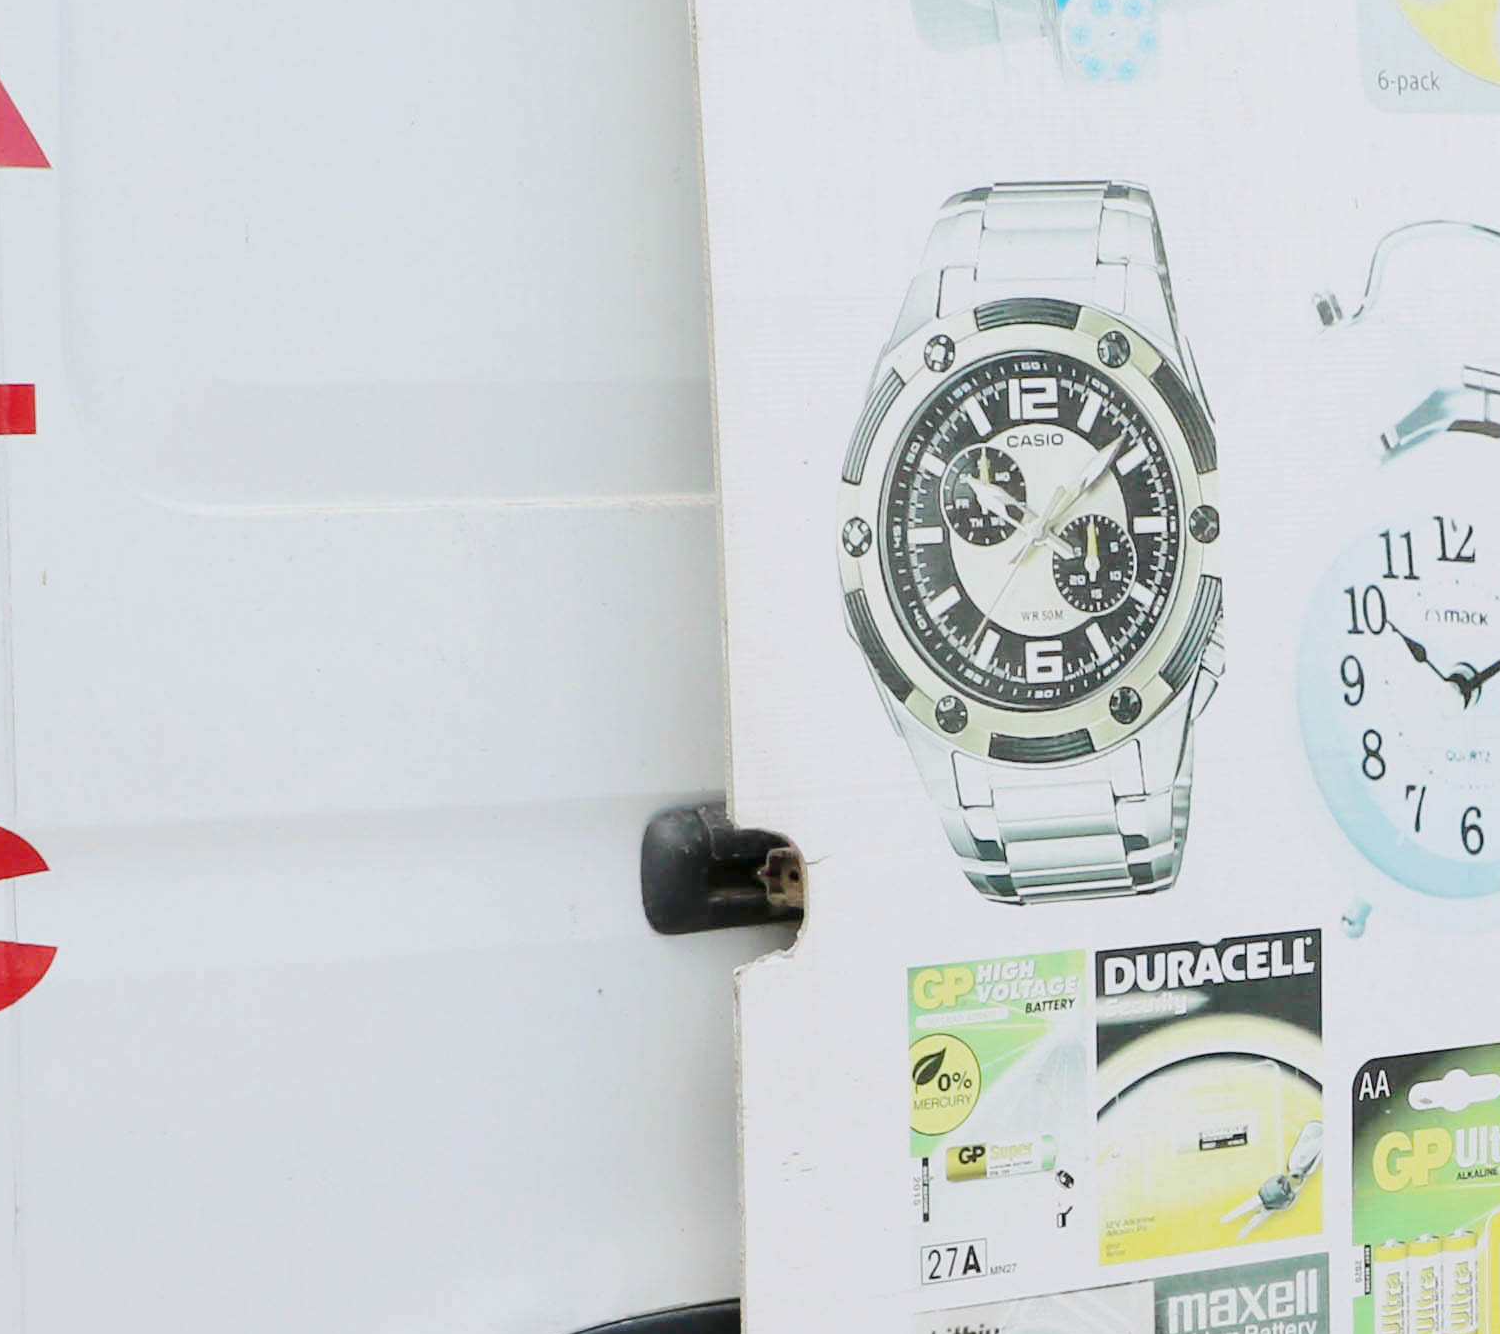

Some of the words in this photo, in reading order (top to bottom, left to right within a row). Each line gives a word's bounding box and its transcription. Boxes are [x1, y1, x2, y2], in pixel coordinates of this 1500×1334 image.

[1378, 71, 1440, 93] 6-pack
[1008, 377, 1059, 420] 12
[1006, 433, 1064, 448] CASIO
[1379, 529, 1420, 580] 11
[1344, 585, 1387, 634] 10
[1025, 640, 1063, 684] 6
[1341, 655, 1364, 706] 9
[1362, 729, 1386, 780] 8
[1461, 807, 1483, 855] 6
[913, 967, 974, 1010] GP
[976, 960, 1035, 983] HIGH
[1104, 937, 1315, 996] DURACELL
[977, 975, 1078, 1003] VOLTAGE
[1025, 998, 1076, 1014] BATTERY
[913, 1095, 973, 1111] MERCURY
[938, 1071, 972, 1092] 0%
[1359, 1070, 1390, 1101] AA
[958, 1144, 986, 1165] GP
[1373, 1128, 1453, 1191] GP
[1456, 1168, 1499, 1180] ALKALINE
[928, 1245, 982, 1280] 27A
[1168, 1268, 1318, 1334] maxell
[1416, 1267, 1435, 1334] Ultra
[1451, 1261, 1470, 1330] Ultra
